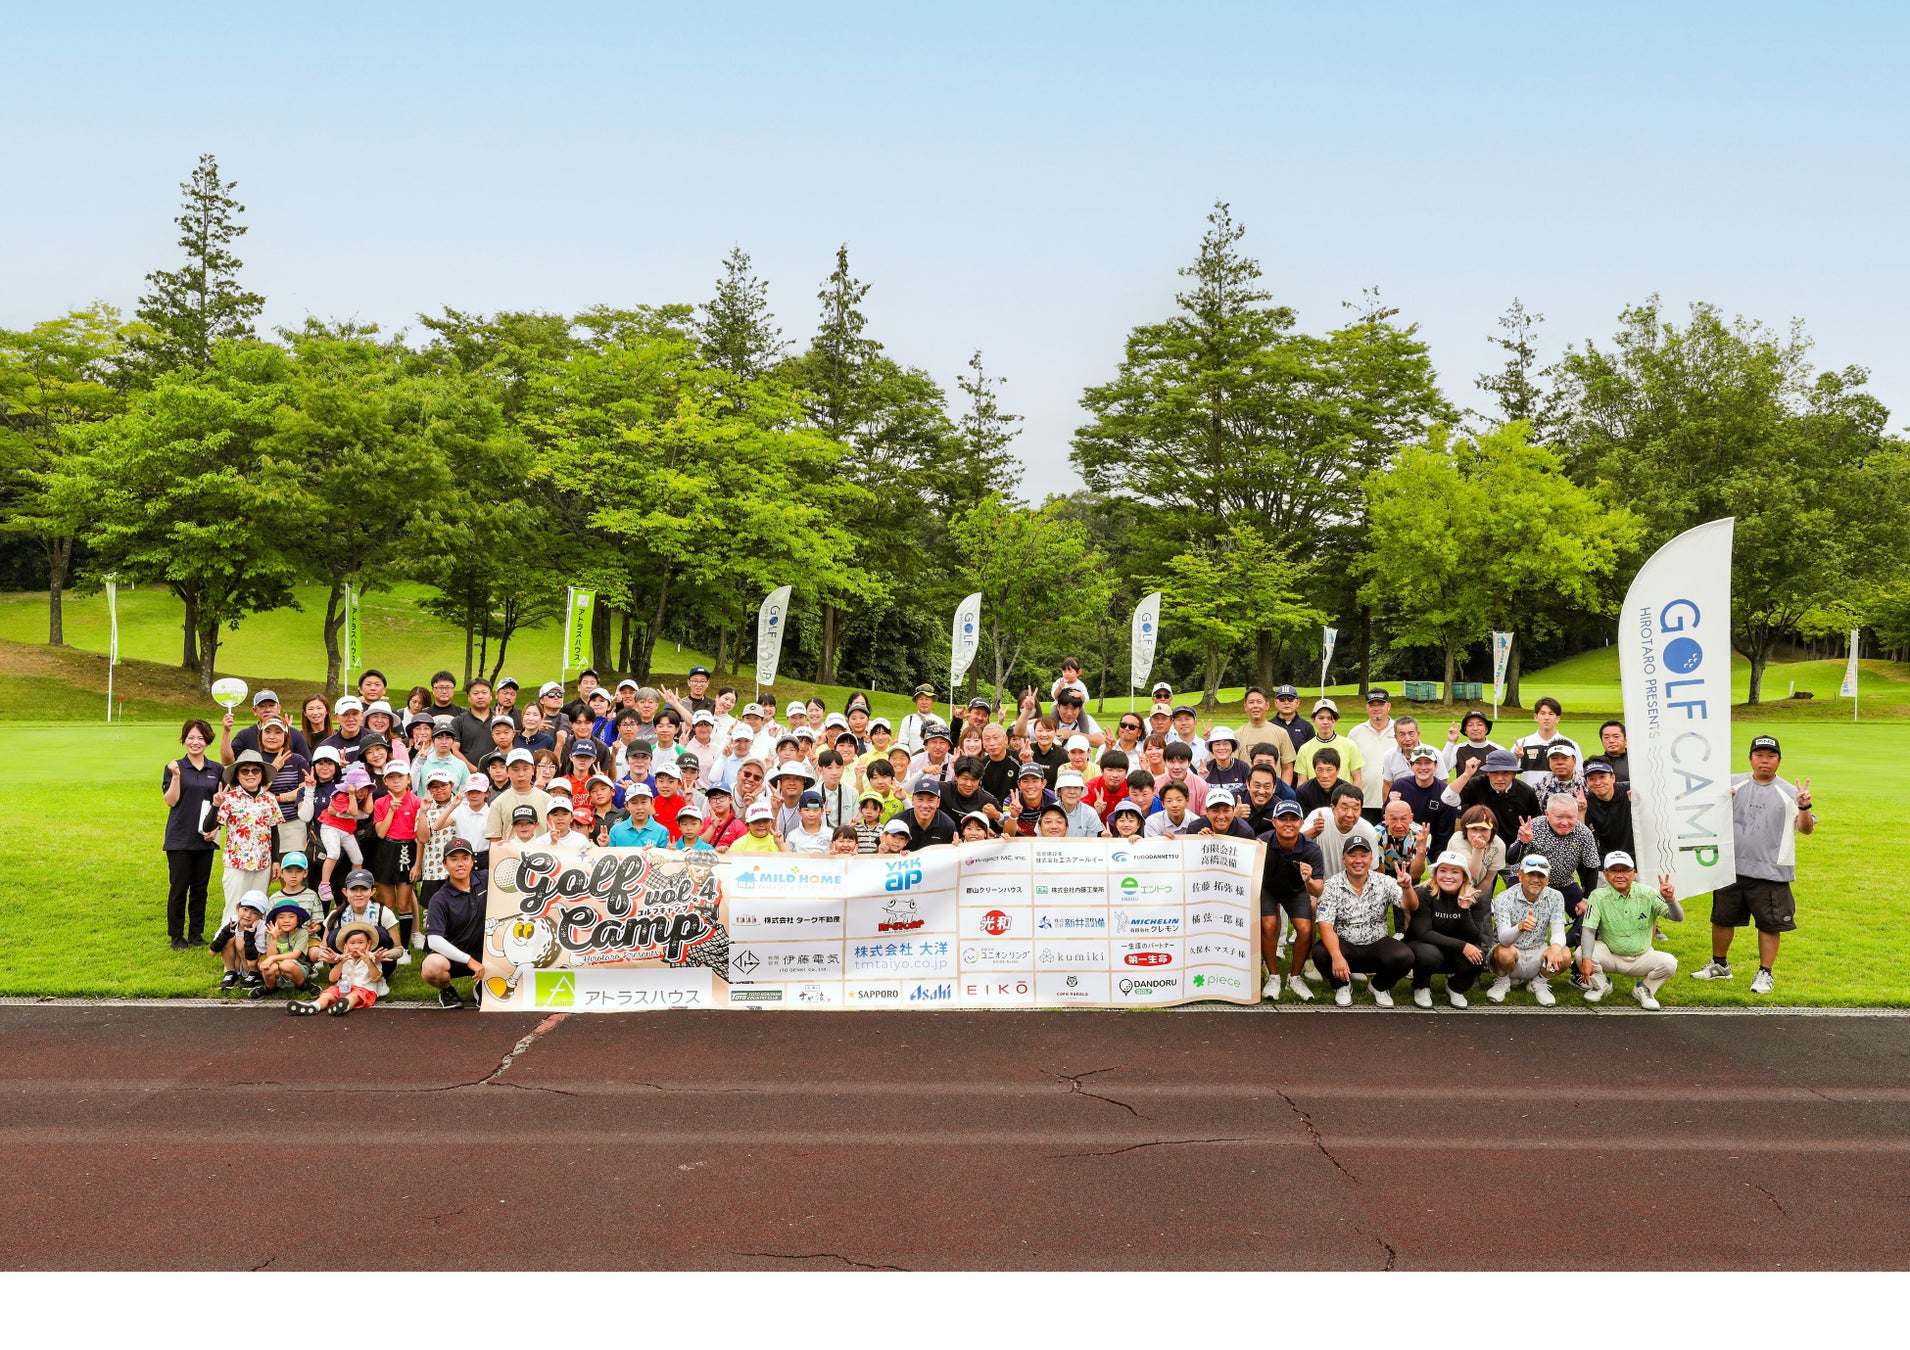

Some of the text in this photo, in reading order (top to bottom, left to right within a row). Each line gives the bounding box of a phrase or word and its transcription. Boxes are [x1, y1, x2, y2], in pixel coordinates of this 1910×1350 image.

[768, 605, 781, 638] GOLF
[1141, 612, 1152, 645] GOLF
[574, 608, 585, 661] アトラスハウス
[963, 612, 974, 647] GOLF
[1640, 606, 1661, 739] HIROTARO PRESENTS
[1660, 598, 1720, 868] GOLF CAMP
[1201, 844, 1238, 857] 有限会社
[885, 857, 922, 871] YKK
[1201, 855, 1237, 868] 高橋設備
[515, 851, 645, 920] Golf
[759, 873, 841, 884] MILD HOME
[885, 869, 922, 891] ap
[966, 886, 1022, 894] 郡山クリーンハウス
[1140, 885, 1173, 894] エンドウ
[1192, 881, 1245, 896] 佐藤 拓弥 様
[763, 916, 794, 924] 株式会社
[979, 915, 1012, 931] 光和
[1203, 912, 1233, 924] 弦一郎
[1235, 916, 1244, 928] 様
[558, 905, 713, 962] Camp
[1151, 925, 1179, 933] クレモン
[854, 941, 949, 958] 株式会社 大洋
[1121, 942, 1174, 950] 一生涯のパートナー
[783, 953, 840, 965] 伊藤電気
[1057, 951, 1104, 961] kumiki
[1128, 954, 1168, 964] 第一生命
[1238, 949, 1246, 959] 様
[855, 957, 948, 971] tmtaiyo.co.jp
[1134, 978, 1177, 988] DANDORU
[1206, 974, 1241, 988] piece
[585, 989, 701, 1005] アトラスハウス
[857, 989, 899, 999] SAPPORO
[909, 983, 952, 1001] Asahi
